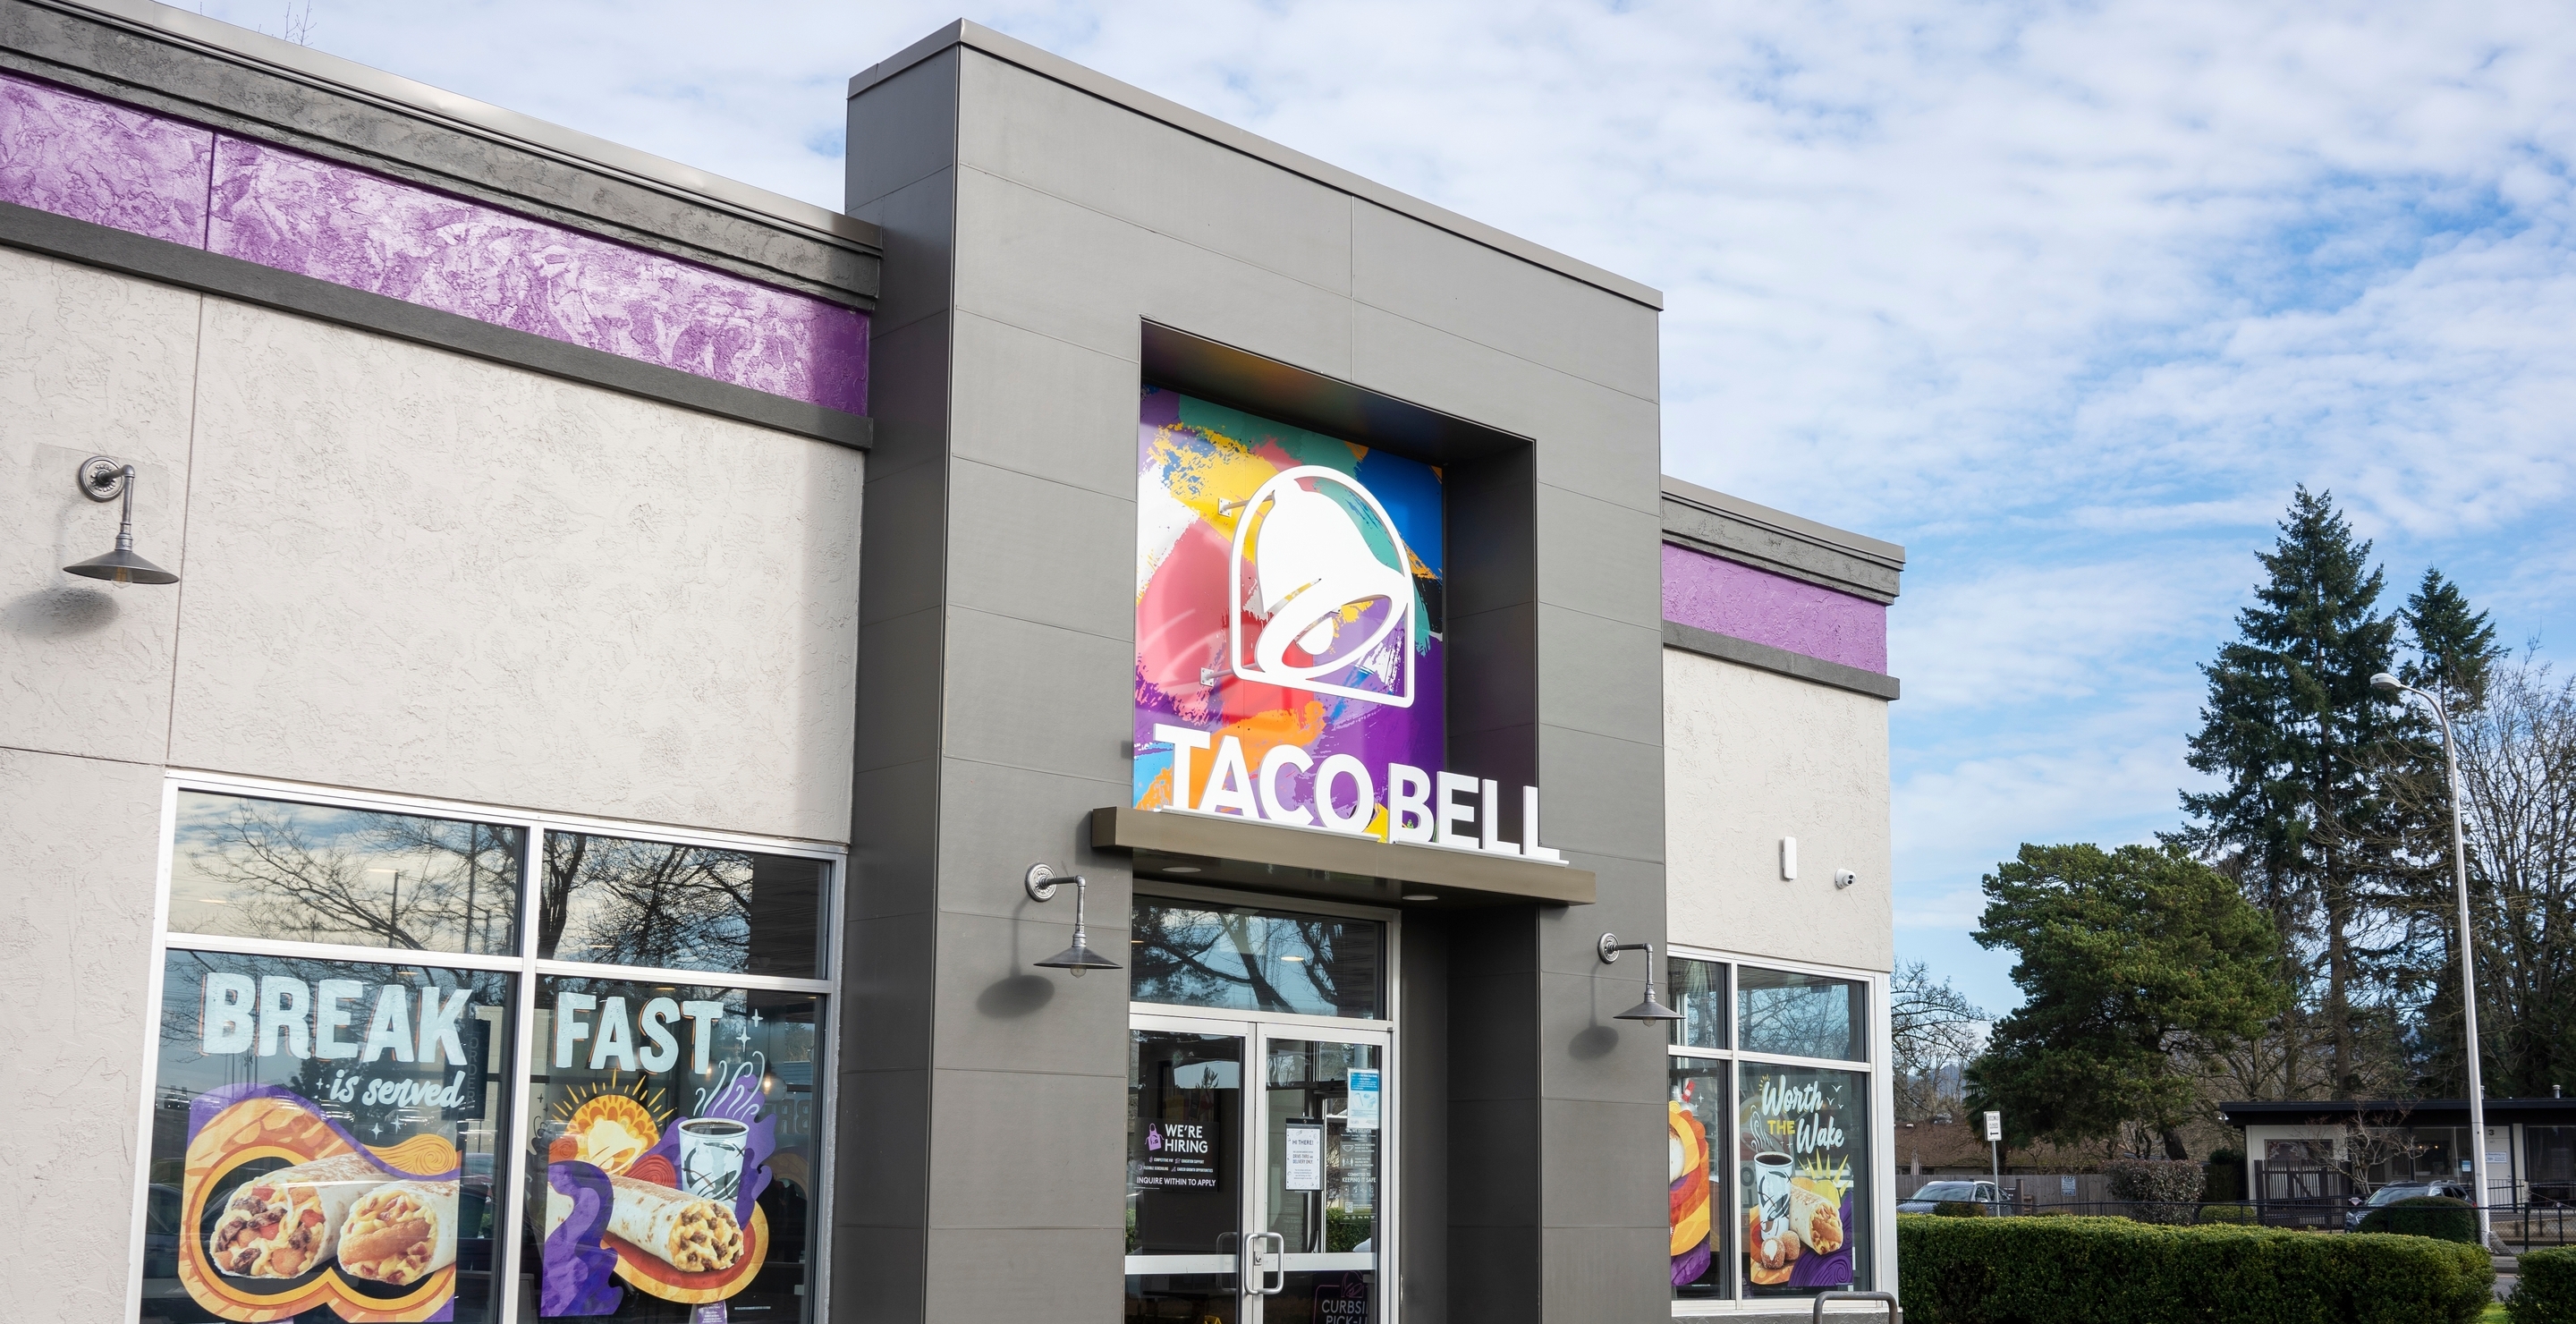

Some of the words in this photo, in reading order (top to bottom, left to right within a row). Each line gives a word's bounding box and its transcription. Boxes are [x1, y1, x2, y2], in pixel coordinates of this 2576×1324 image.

[1153, 723, 1376, 833] TACO
[1388, 762, 1560, 860] BELL
[199, 972, 472, 1065] BREAK
[554, 992, 724, 1074] FAST
[329, 1070, 359, 1102] is
[362, 1070, 466, 1108] served
[1762, 1074, 1823, 1116] Worth
[1165, 1124, 1203, 1138] WE'RE
[1165, 1139, 1208, 1153] HIRING
[1767, 1120, 1795, 1135] THE
[1797, 1113, 1844, 1154] Wake
[1136, 1176, 1163, 1184] INQUIRE
[1164, 1177, 1187, 1185] WITHIN
[1188, 1178, 1197, 1186] TO
[1198, 1179, 1216, 1187] APPLY
